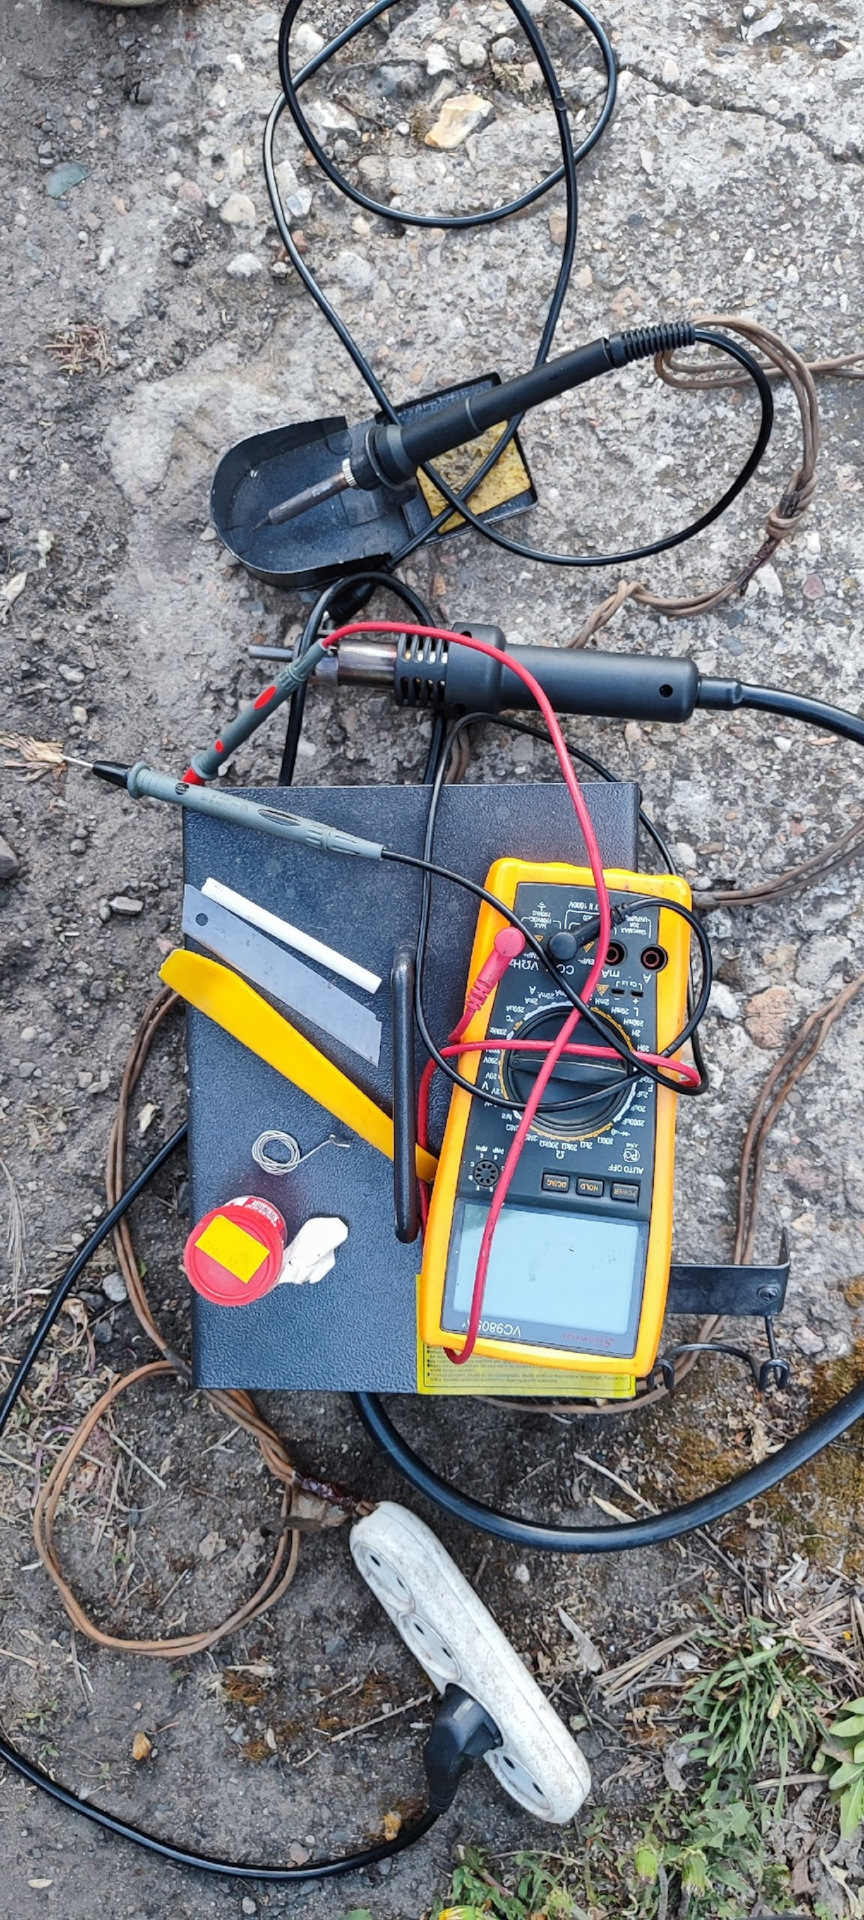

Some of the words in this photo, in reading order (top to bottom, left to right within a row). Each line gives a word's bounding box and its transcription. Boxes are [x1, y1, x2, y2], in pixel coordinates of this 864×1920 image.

[601, 969, 620, 978] mA
[642, 973, 652, 984] A
[528, 985, 536, 995] A
[594, 998, 610, 1006] 2mH
[481, 1081, 489, 1090] V
[608, 1164, 622, 1172] OFF
[624, 1166, 644, 1174] AUTO
[546, 1178, 567, 1188] DC/AC
[580, 1182, 599, 1192] HOLD
[613, 1188, 637, 1198] POWER
